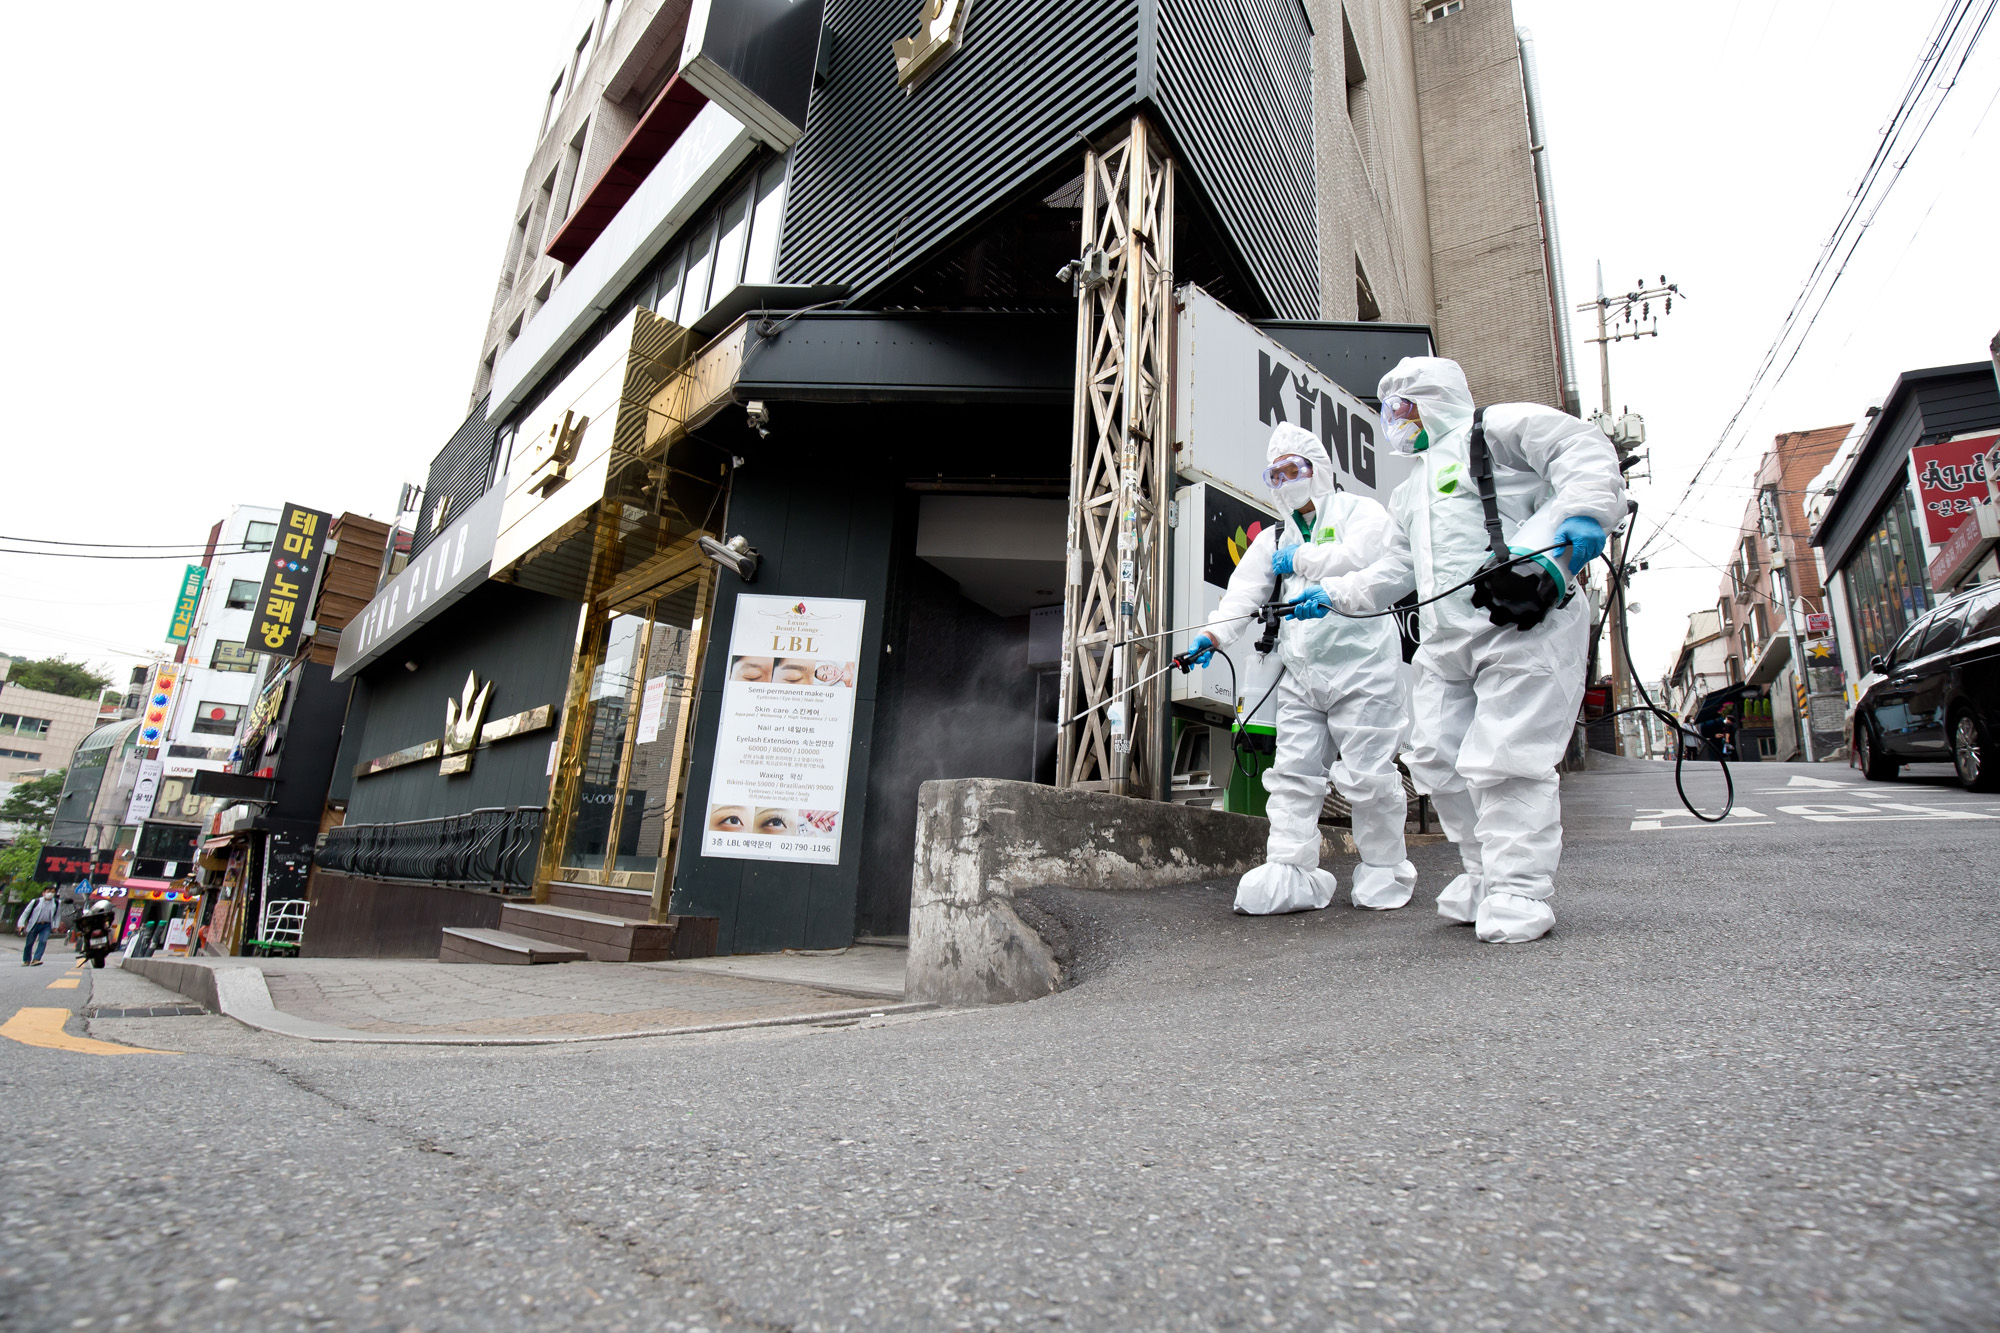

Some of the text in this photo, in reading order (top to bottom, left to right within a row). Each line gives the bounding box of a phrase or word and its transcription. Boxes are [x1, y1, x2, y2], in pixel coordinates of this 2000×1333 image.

[1258, 348, 1376, 491] KING
[282, 509, 319, 560] 테마
[406, 522, 469, 614] CLUB
[260, 573, 300, 649] 노래방
[787, 619, 809, 627] Luxury
[797, 626, 819, 634] Lounge
[771, 635, 819, 653] LBL
[748, 686, 835, 699] Semi-permanent make-up
[754, 705, 770, 713] Skin
[792, 708, 820, 716] 스킨케어
[787, 726, 815, 734] 네일아트
[736, 735, 834, 748] Eyelash Extensions 속눈썹연장
[772, 746, 792, 754] 80000
[171, 766, 194, 774] LOUNGE
[759, 772, 803, 781] Waxing 왁싱
[726, 779, 757, 787] Bikini-line
[757, 780, 775, 788] 59000
[779, 782, 815, 790] Brazilian(W)
[711, 838, 831, 853] 3층 LBL 예약문의 02) 790 -1196
